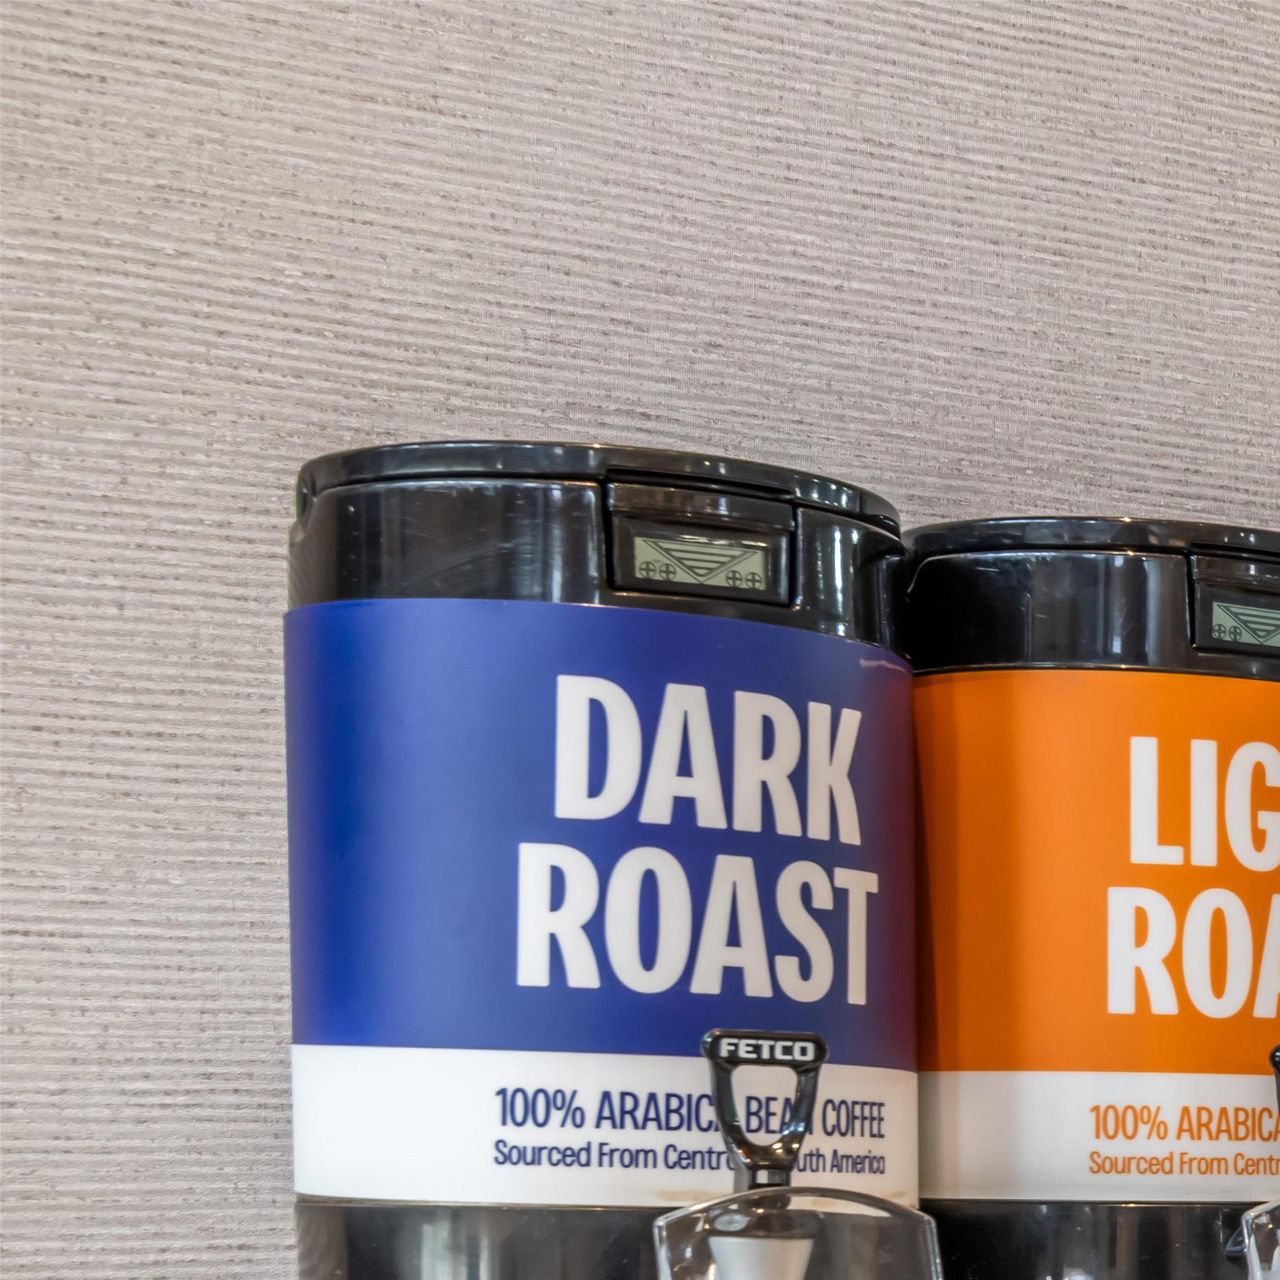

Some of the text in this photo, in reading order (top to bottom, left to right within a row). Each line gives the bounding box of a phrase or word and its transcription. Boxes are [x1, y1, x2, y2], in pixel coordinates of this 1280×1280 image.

[555, 674, 862, 846] DARK
[518, 843, 879, 1006] ROAST
[719, 1038, 816, 1062] FETCO
[495, 1087, 885, 1139] 100% ARABIC BEA COFFEE
[1089, 1104, 1168, 1141] 100%
[494, 1139, 592, 1168] Sourced
[598, 1141, 658, 1170] From
[663, 1144, 736, 1172] Centr
[831, 1149, 885, 1175] America
[1089, 1151, 1174, 1175] Sourced
[1179, 1152, 1228, 1176] From
